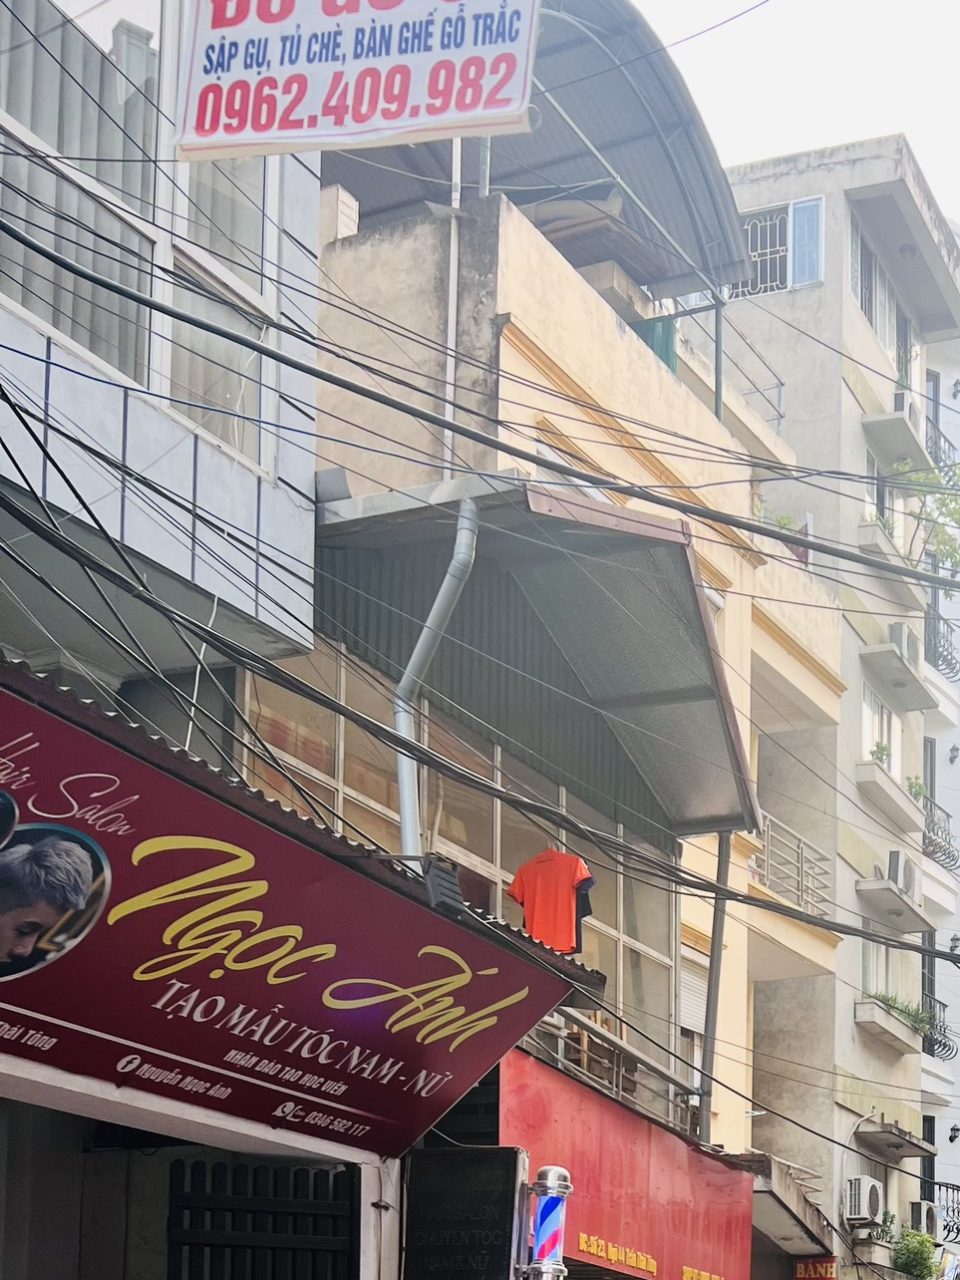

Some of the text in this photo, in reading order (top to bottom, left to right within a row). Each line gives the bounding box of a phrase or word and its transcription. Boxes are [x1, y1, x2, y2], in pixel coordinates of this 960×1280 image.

[203, 35, 239, 81] SẬP
[244, 37, 271, 76] GỤ,
[279, 23, 302, 66] TỦ
[306, 22, 346, 66] CHÈ,
[353, 18, 393, 60] BÀN
[398, 7, 438, 55] GHẾ
[440, 3, 466, 50] GỖ
[195, 52, 517, 137] 0962.409.982
[27, 773, 139, 835] Salon
[107, 836, 336, 986] Ngọc
[20, 1028, 58, 1050] Tông
[152, 979, 453, 1097] TẠO MẪU TÓC NAM NỮ
[136, 1063, 181, 1085] Nguyễn
[177, 1075, 211, 1094] Ngọc
[223, 1049, 348, 1096] NHẬN ĐÀO TẠO HỌC VIÊN
[349, 1122, 370, 1137] 117
